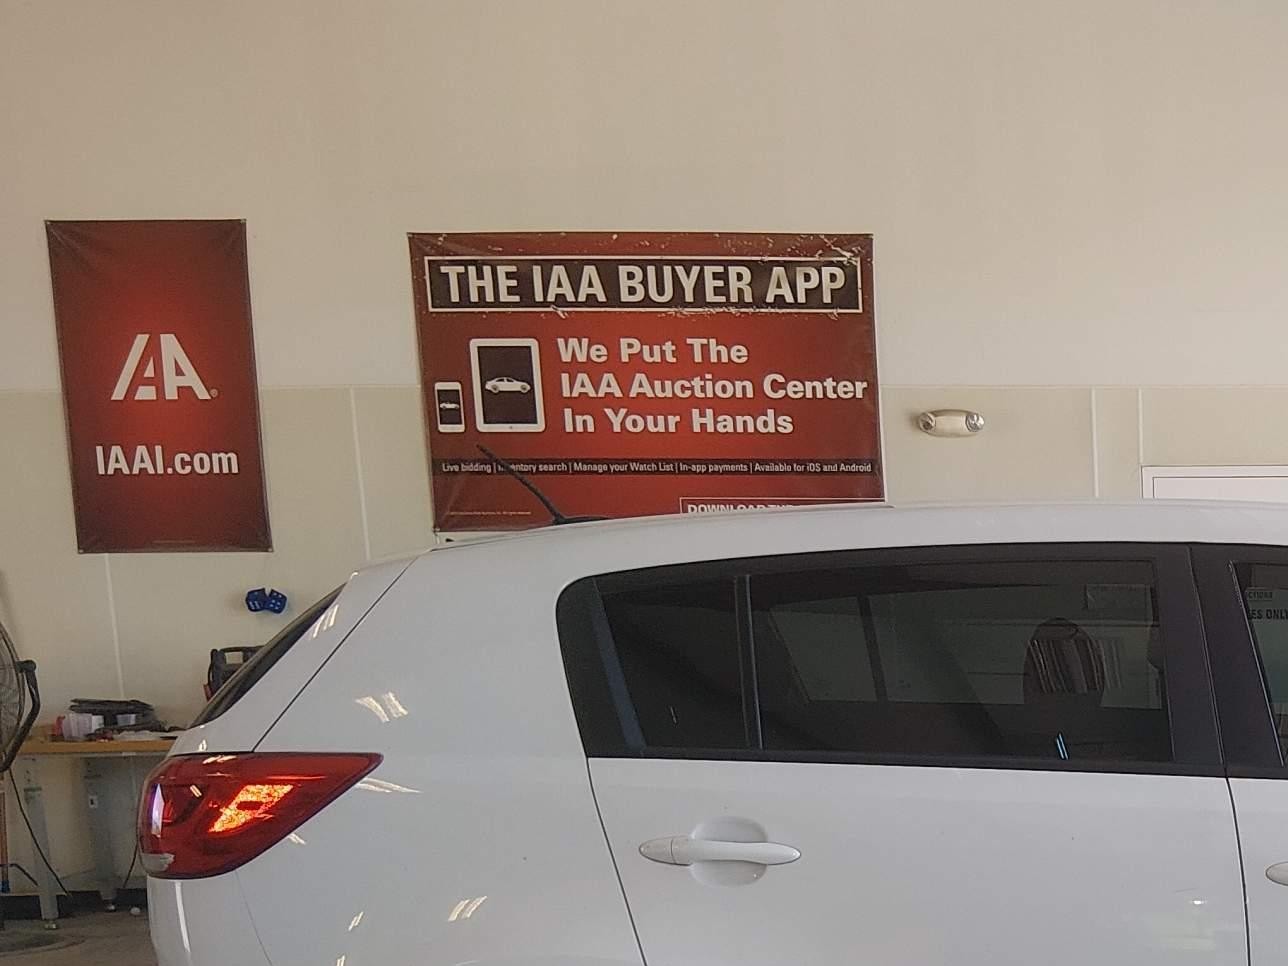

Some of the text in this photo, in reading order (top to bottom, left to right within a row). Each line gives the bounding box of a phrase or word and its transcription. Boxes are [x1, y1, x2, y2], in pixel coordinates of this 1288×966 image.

[440, 265, 846, 304] THE IAA BUYER APP
[557, 338, 749, 363] We Put The
[561, 373, 868, 399] IAA Auction Center
[564, 408, 794, 433] In Your Hands
[95, 445, 239, 475] IAAI.com
[442, 462, 460, 472] Live
[461, 462, 492, 474] bidding
[538, 462, 567, 472] search
[573, 462, 608, 474] Manage
[609, 464, 628, 474] your
[629, 462, 657, 472] Watch
[658, 462, 674, 472] List
[679, 462, 707, 474] In-app
[708, 463, 748, 474] payments
[754, 462, 792, 472] Available
[793, 462, 806, 472] for
[806, 462, 821, 472] iOS
[822, 462, 838, 472] and
[839, 462, 872, 472] Android
